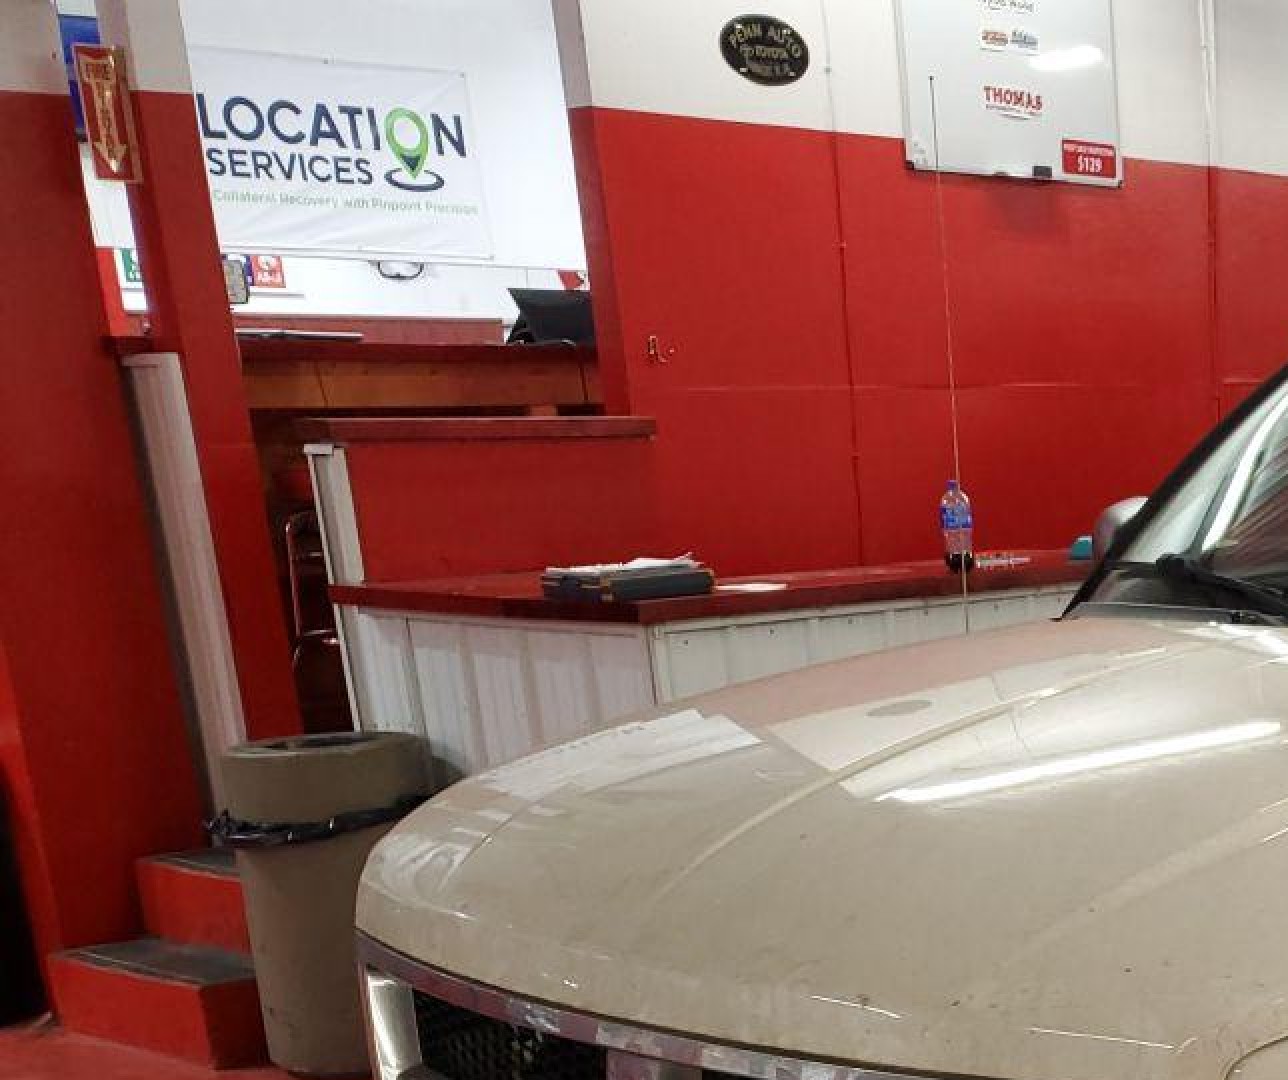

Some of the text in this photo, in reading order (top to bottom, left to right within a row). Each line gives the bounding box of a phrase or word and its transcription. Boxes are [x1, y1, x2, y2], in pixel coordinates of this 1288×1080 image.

[983, 85, 1043, 111] THOMAS
[196, 93, 467, 160] LOCATION
[208, 149, 373, 185] SERVICES
